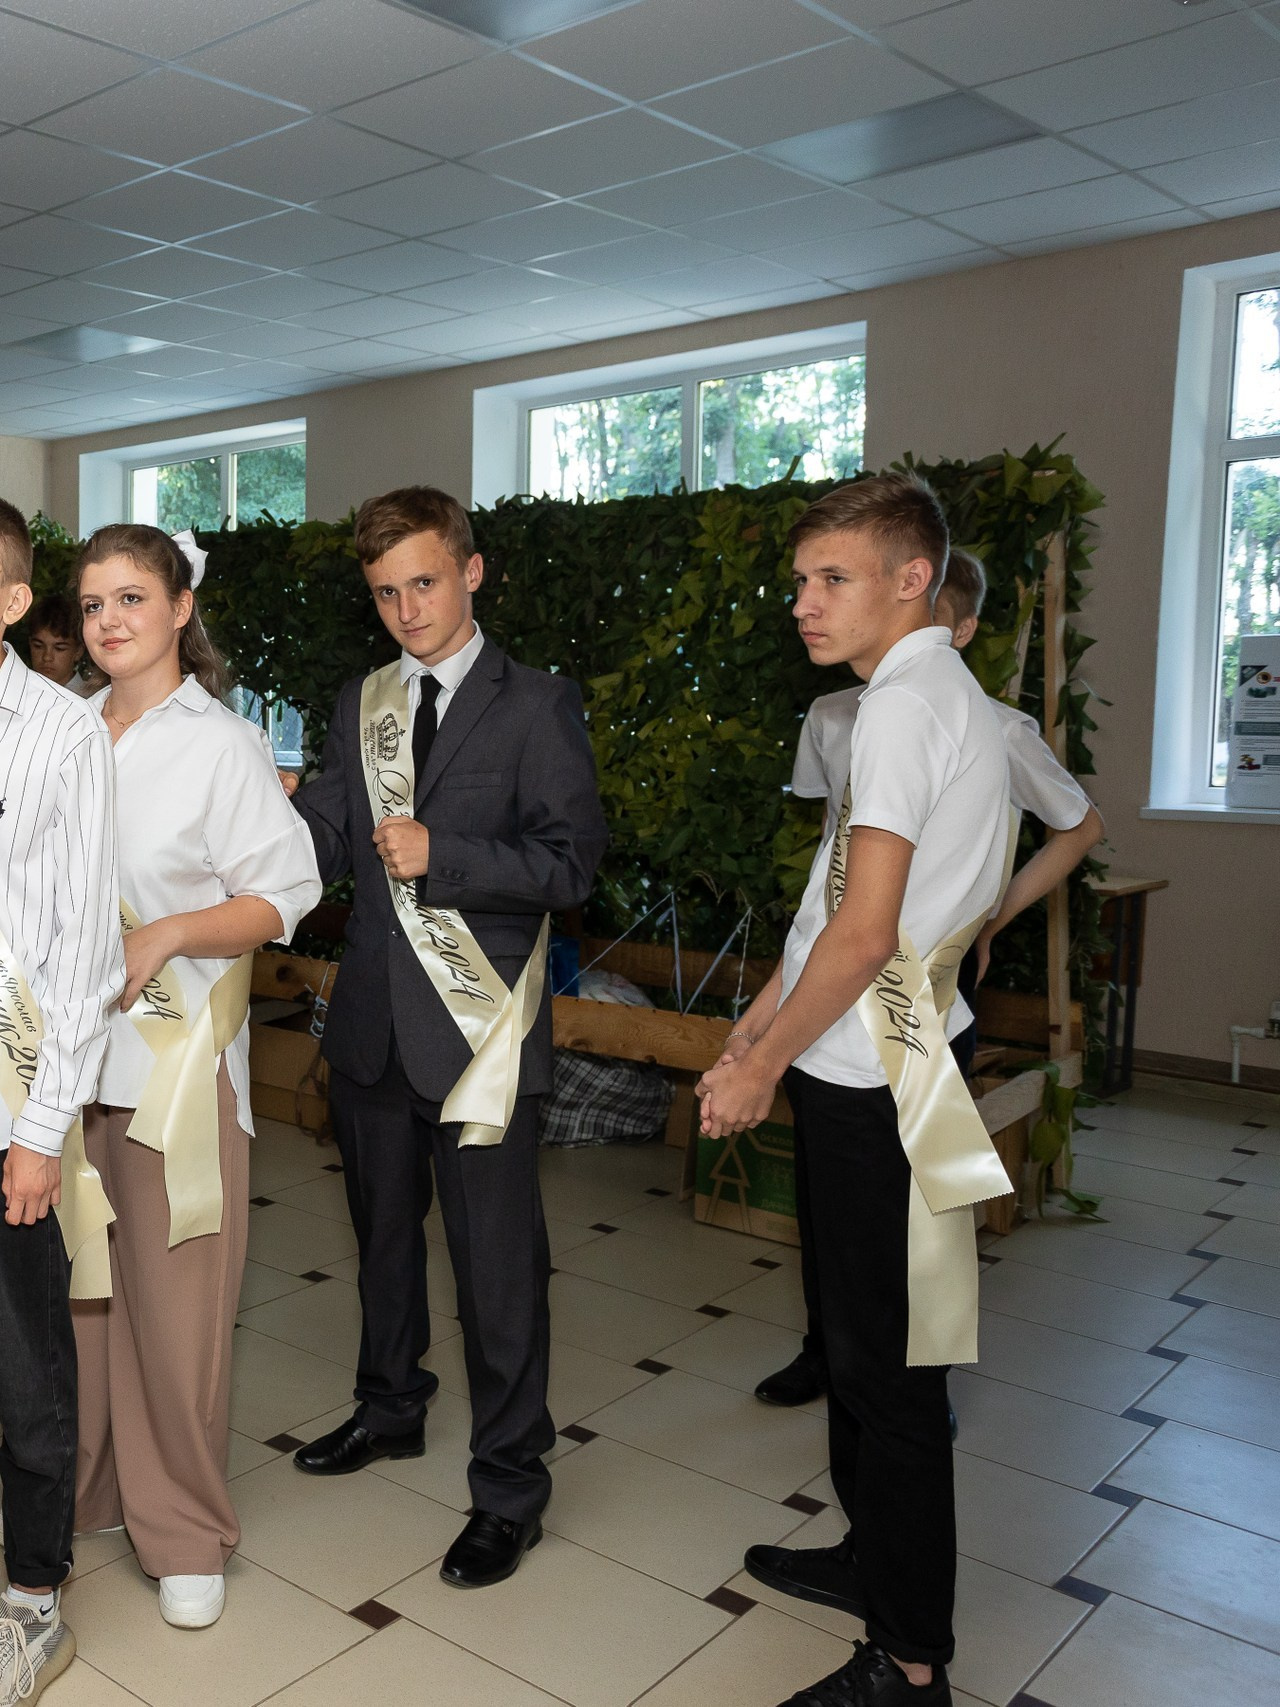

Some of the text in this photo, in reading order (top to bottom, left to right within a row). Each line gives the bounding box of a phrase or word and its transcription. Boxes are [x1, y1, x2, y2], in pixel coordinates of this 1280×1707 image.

[431, 929, 495, 1004] 2024
[0, 976, 37, 1033] Ярослав
[872, 969, 929, 1059] 2024
[1, 1039, 38, 1096] 20
